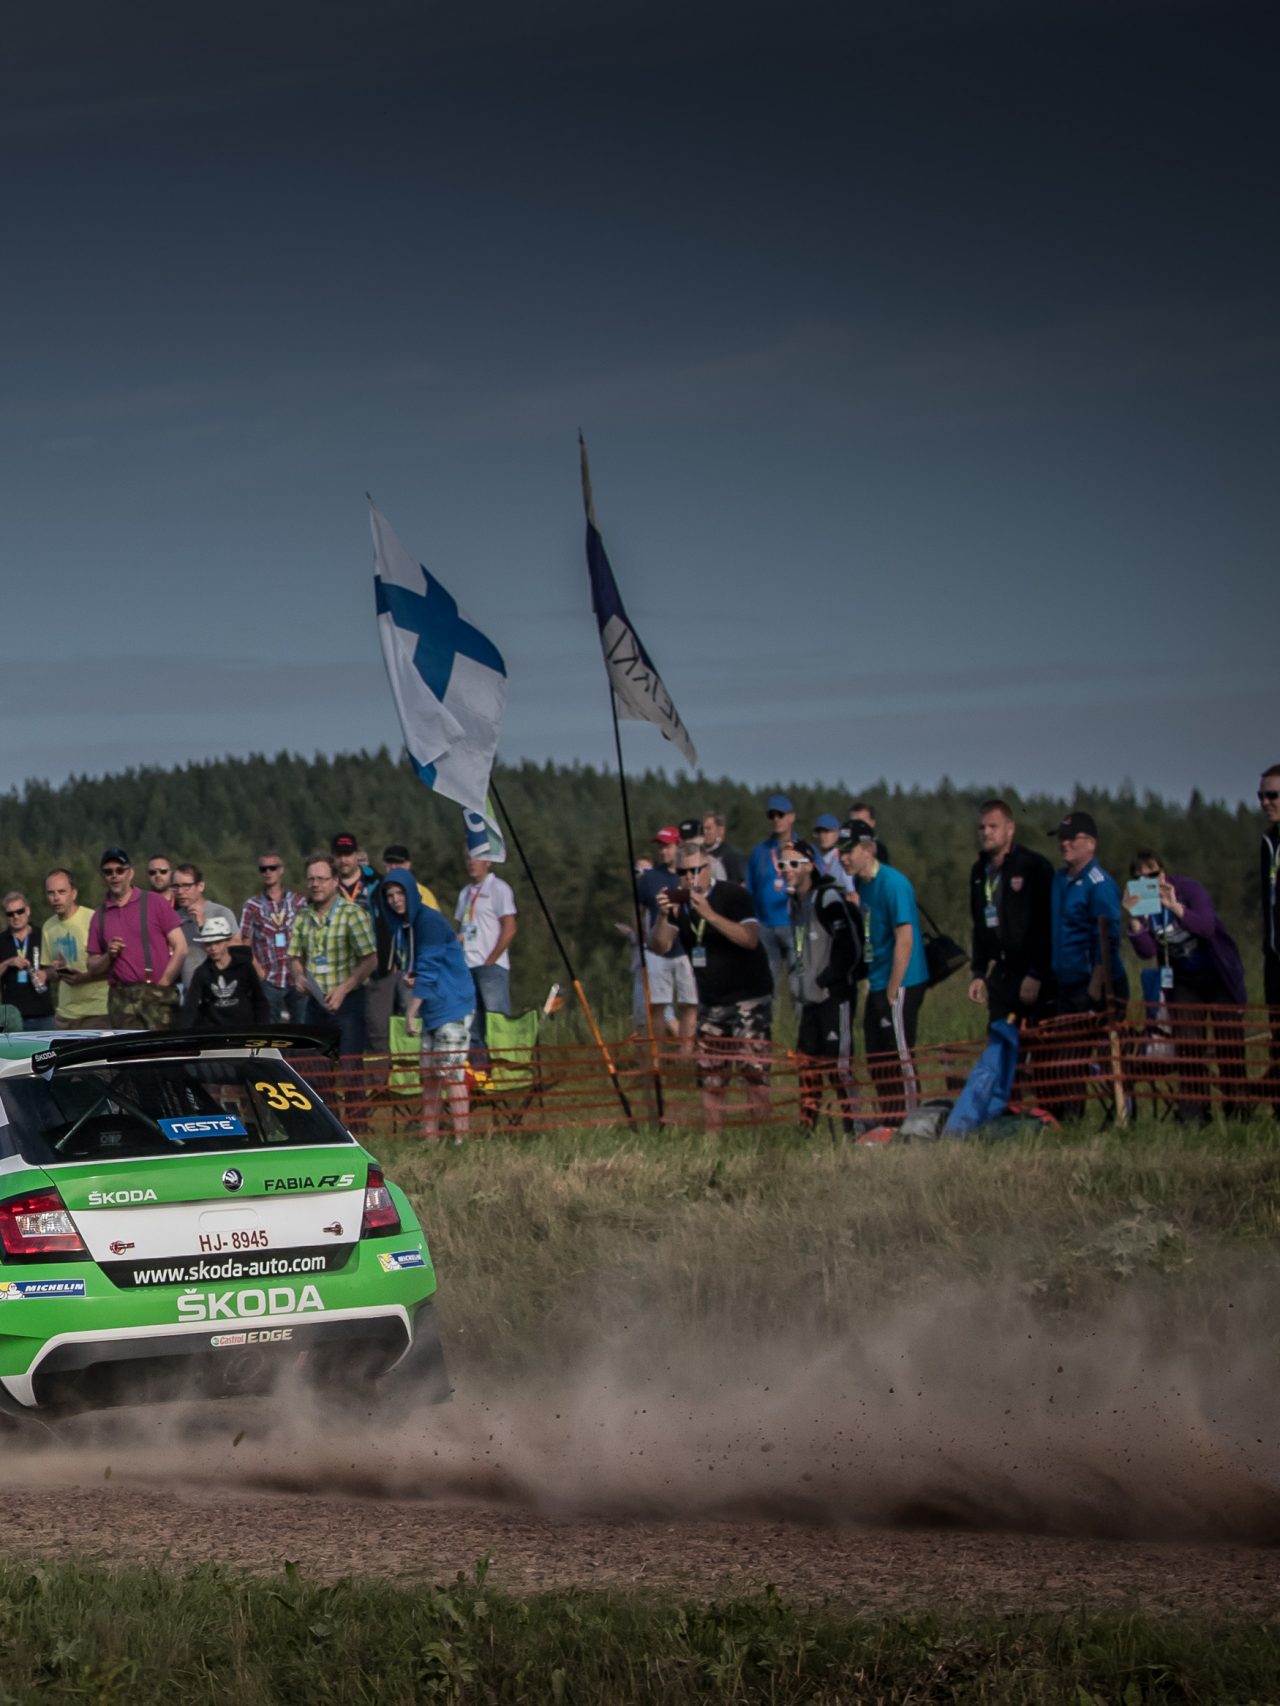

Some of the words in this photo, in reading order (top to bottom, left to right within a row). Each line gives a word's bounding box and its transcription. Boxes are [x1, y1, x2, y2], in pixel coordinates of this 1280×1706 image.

[255, 1082, 313, 1111] 35
[171, 1120, 234, 1134] NESTE
[264, 1177, 315, 1191] FABIA
[317, 1174, 355, 1188] R5
[88, 1188, 158, 1206] ŠKODA
[133, 1256, 326, 1284] www.skoda-auto.com
[24, 1283, 84, 1292] MICHELIN
[176, 1284, 325, 1322] ŠKODA
[219, 1334, 244, 1345] Castrol
[246, 1328, 293, 1344] EDGE
